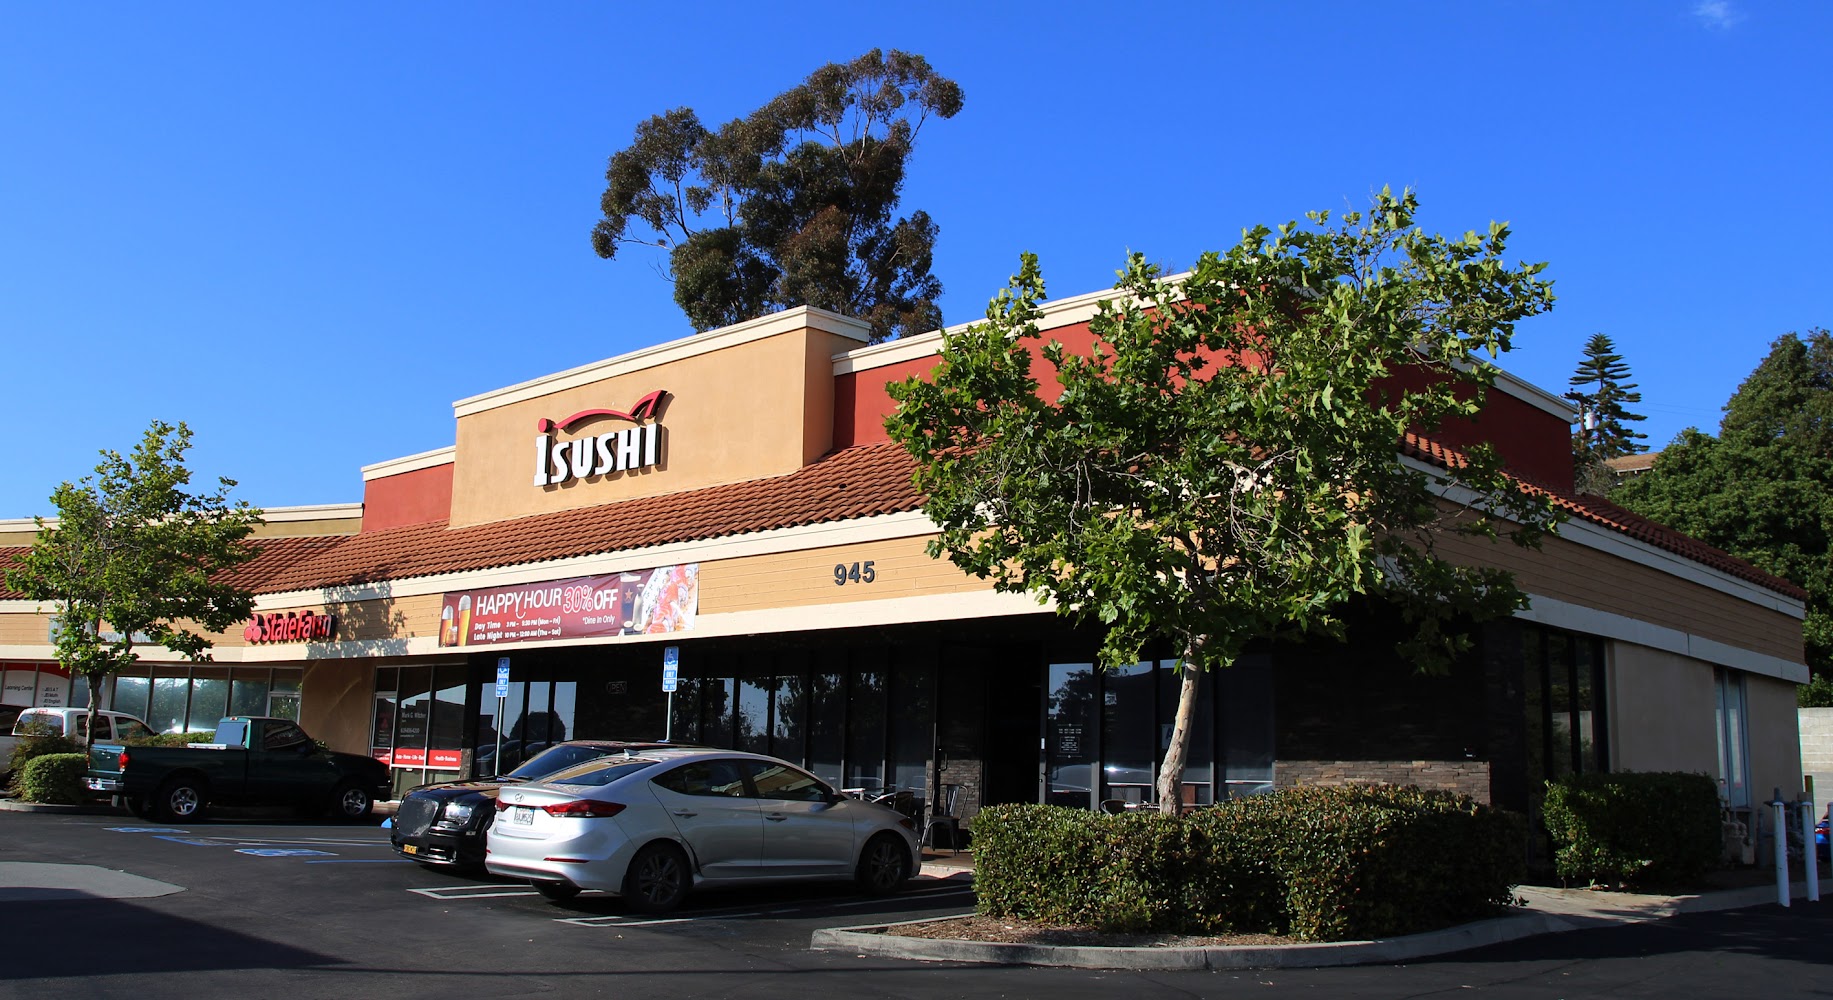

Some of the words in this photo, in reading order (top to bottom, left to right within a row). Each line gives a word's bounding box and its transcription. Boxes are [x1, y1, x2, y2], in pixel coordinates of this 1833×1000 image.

[834, 561, 875, 586] 945
[476, 591, 525, 619] HAPPY
[524, 588, 562, 609] HOUR
[563, 584, 594, 614] 30%
[594, 588, 618, 610] OFF
[603, 615, 616, 625] Only
[474, 622, 486, 632] Day
[487, 621, 501, 629] Time
[473, 632, 486, 641] Late
[486, 631, 503, 642] Night
